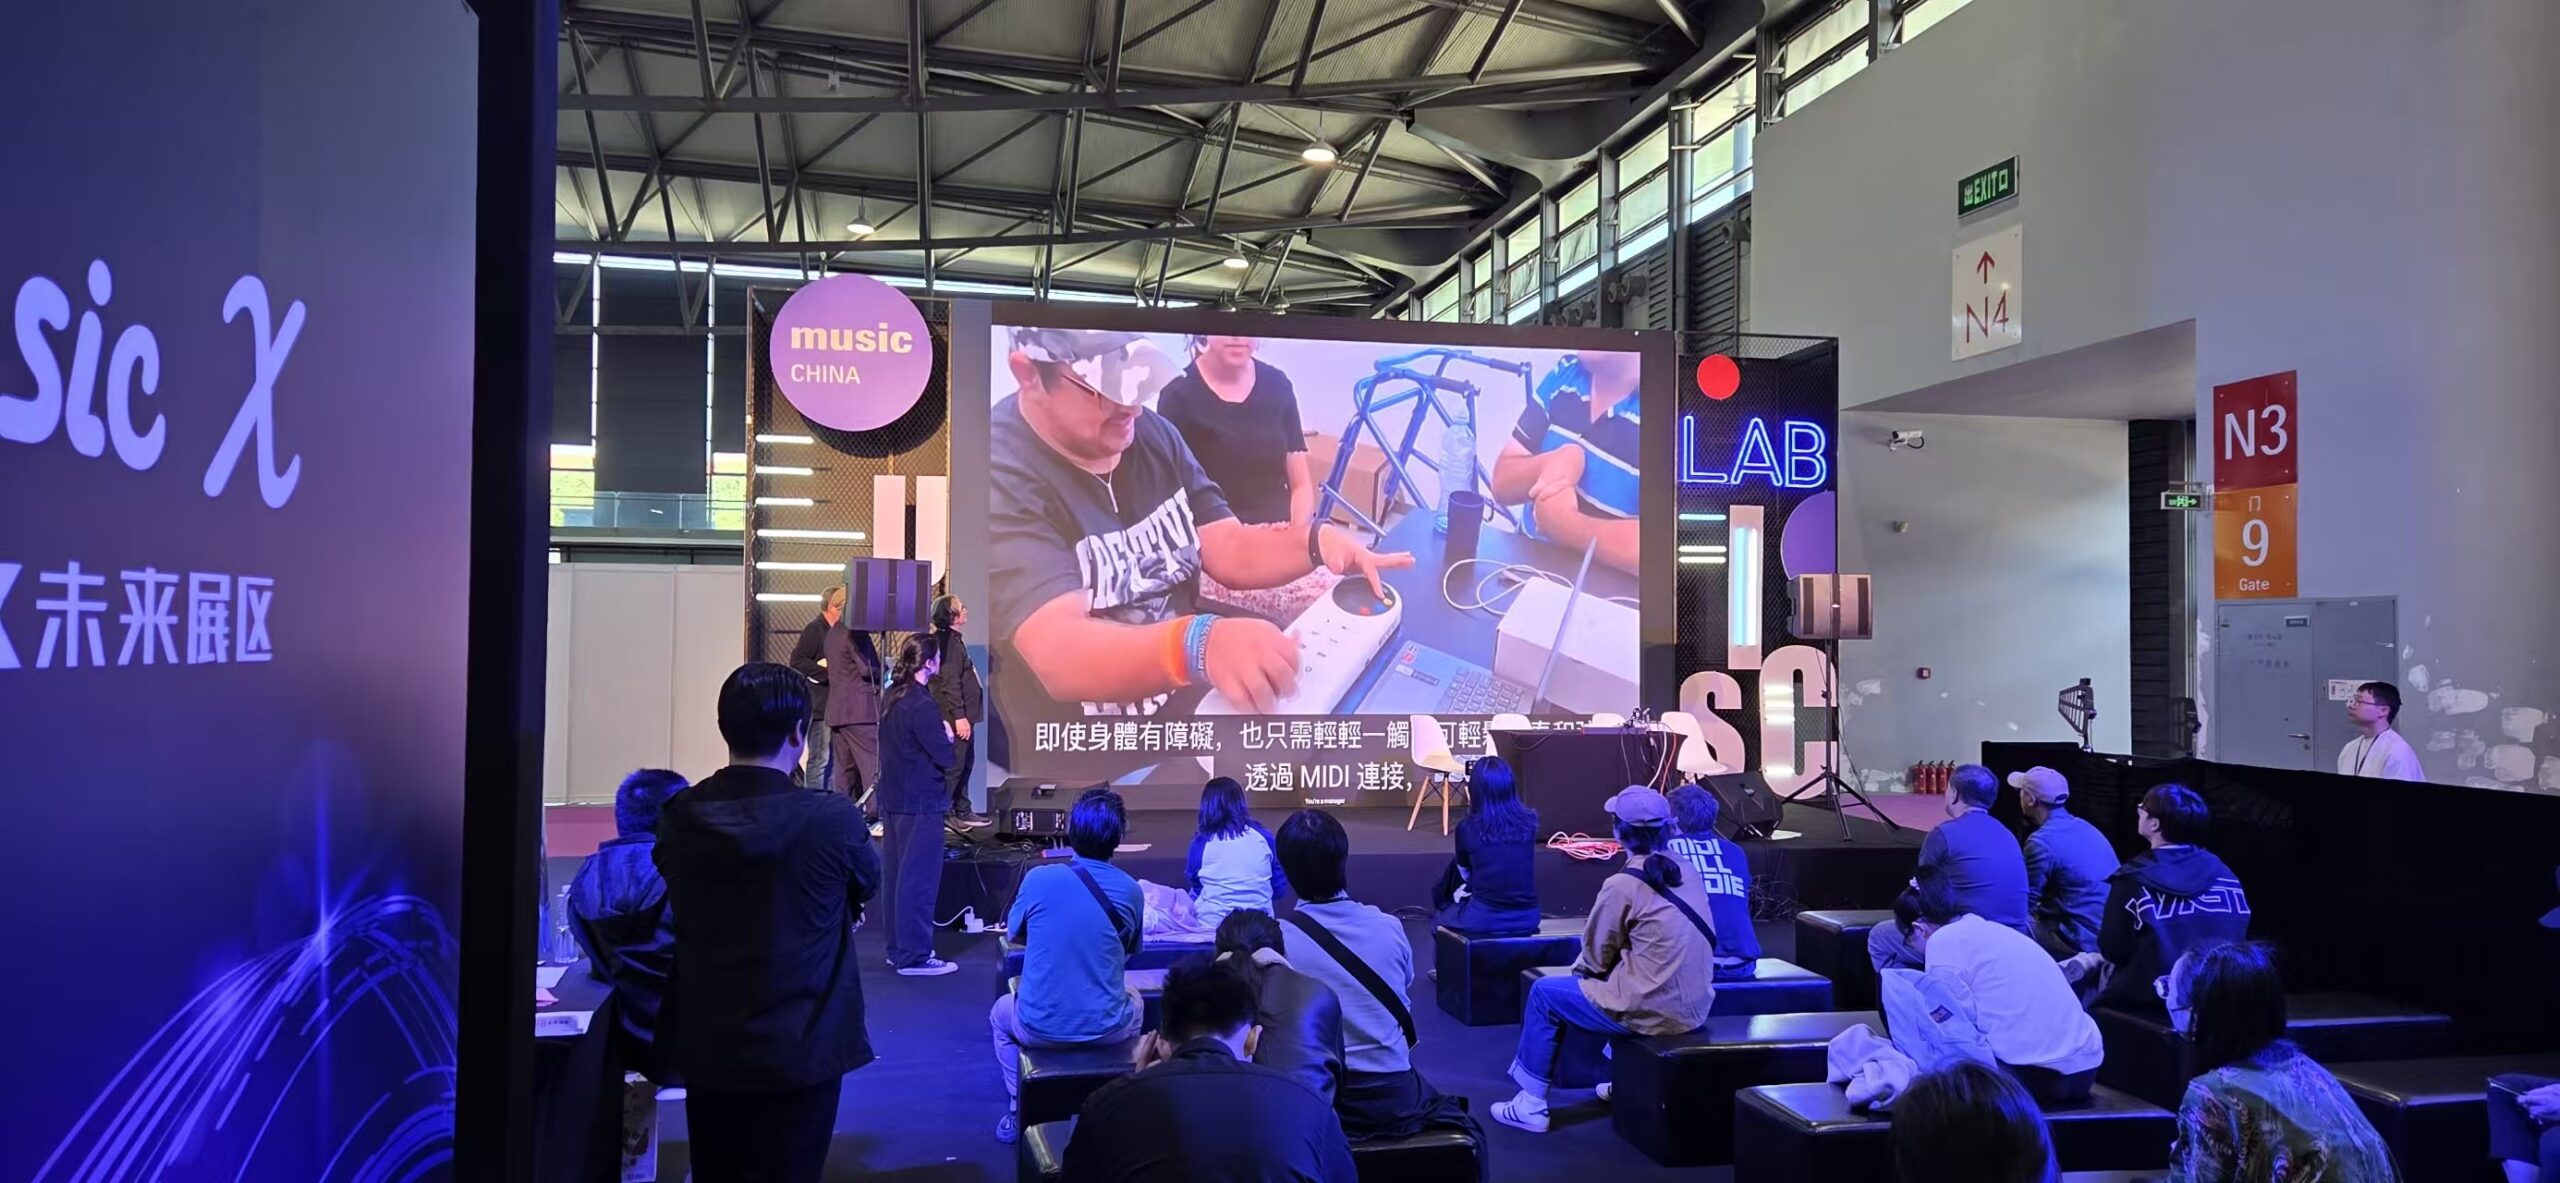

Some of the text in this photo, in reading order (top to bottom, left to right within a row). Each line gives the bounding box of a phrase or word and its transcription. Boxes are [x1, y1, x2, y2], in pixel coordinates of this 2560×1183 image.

[1966, 290, 2010, 343] N4
[791, 322, 913, 354] music
[790, 363, 861, 385] CHINA
[2225, 404, 2288, 461] N3
[1682, 415, 1828, 489] LAB
[2242, 519, 2269, 567] 9
[2239, 577, 2270, 592] Gate
[1245, 762, 1293, 792] 透過
[1300, 765, 1350, 789] MIDI
[1666, 837, 1723, 856] MIDI
[1682, 855, 1733, 875] ILL
[1703, 873, 1746, 898] DIE
